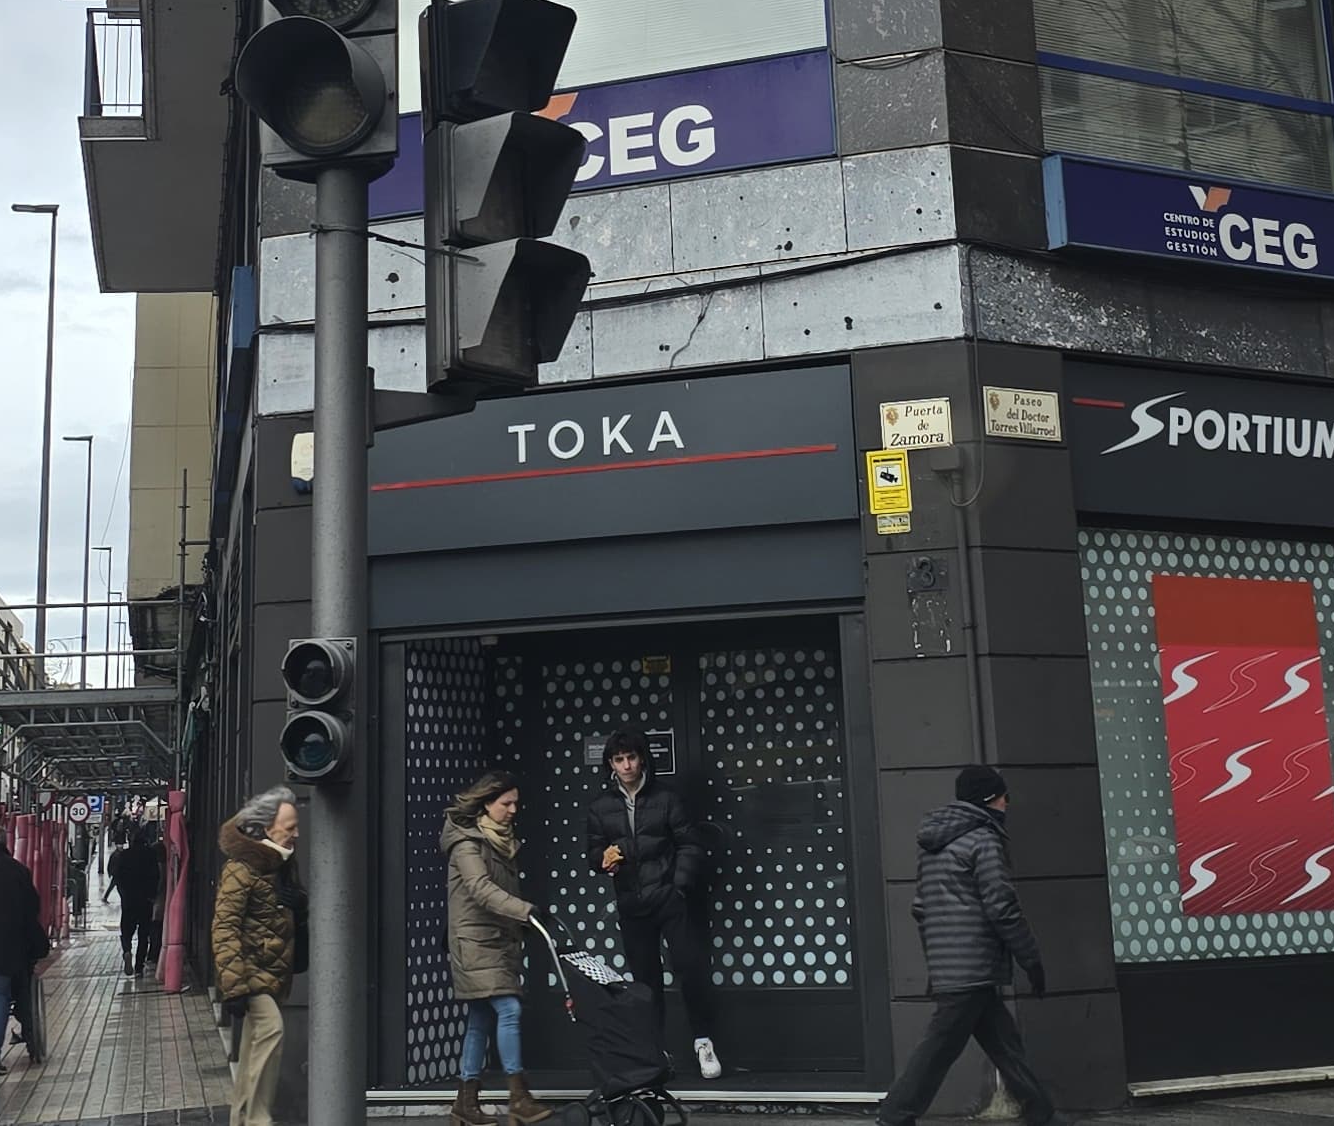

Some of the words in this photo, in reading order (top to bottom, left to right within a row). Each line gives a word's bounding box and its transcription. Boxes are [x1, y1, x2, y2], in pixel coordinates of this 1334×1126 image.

[568, 104, 716, 182] CEG
[1163, 212, 1200, 226] CENTRO
[1202, 217, 1216, 229] DE
[1164, 226, 1217, 242] ESTUDIOS
[1218, 213, 1318, 270] CEG
[1166, 240, 1218, 257] GESTIÓN
[1013, 393, 1043, 407] Paseo
[904, 405, 944, 417] Puerta
[1006, 408, 1020, 421] del
[1021, 409, 1050, 423] Doctor
[916, 419, 930, 431] de
[990, 419, 1018, 434] Torres
[1019, 421, 1056, 436] Villarroel
[508, 410, 685, 465] TOKA
[890, 431, 945, 447] Zamora
[72, 807, 86, 816] 30
